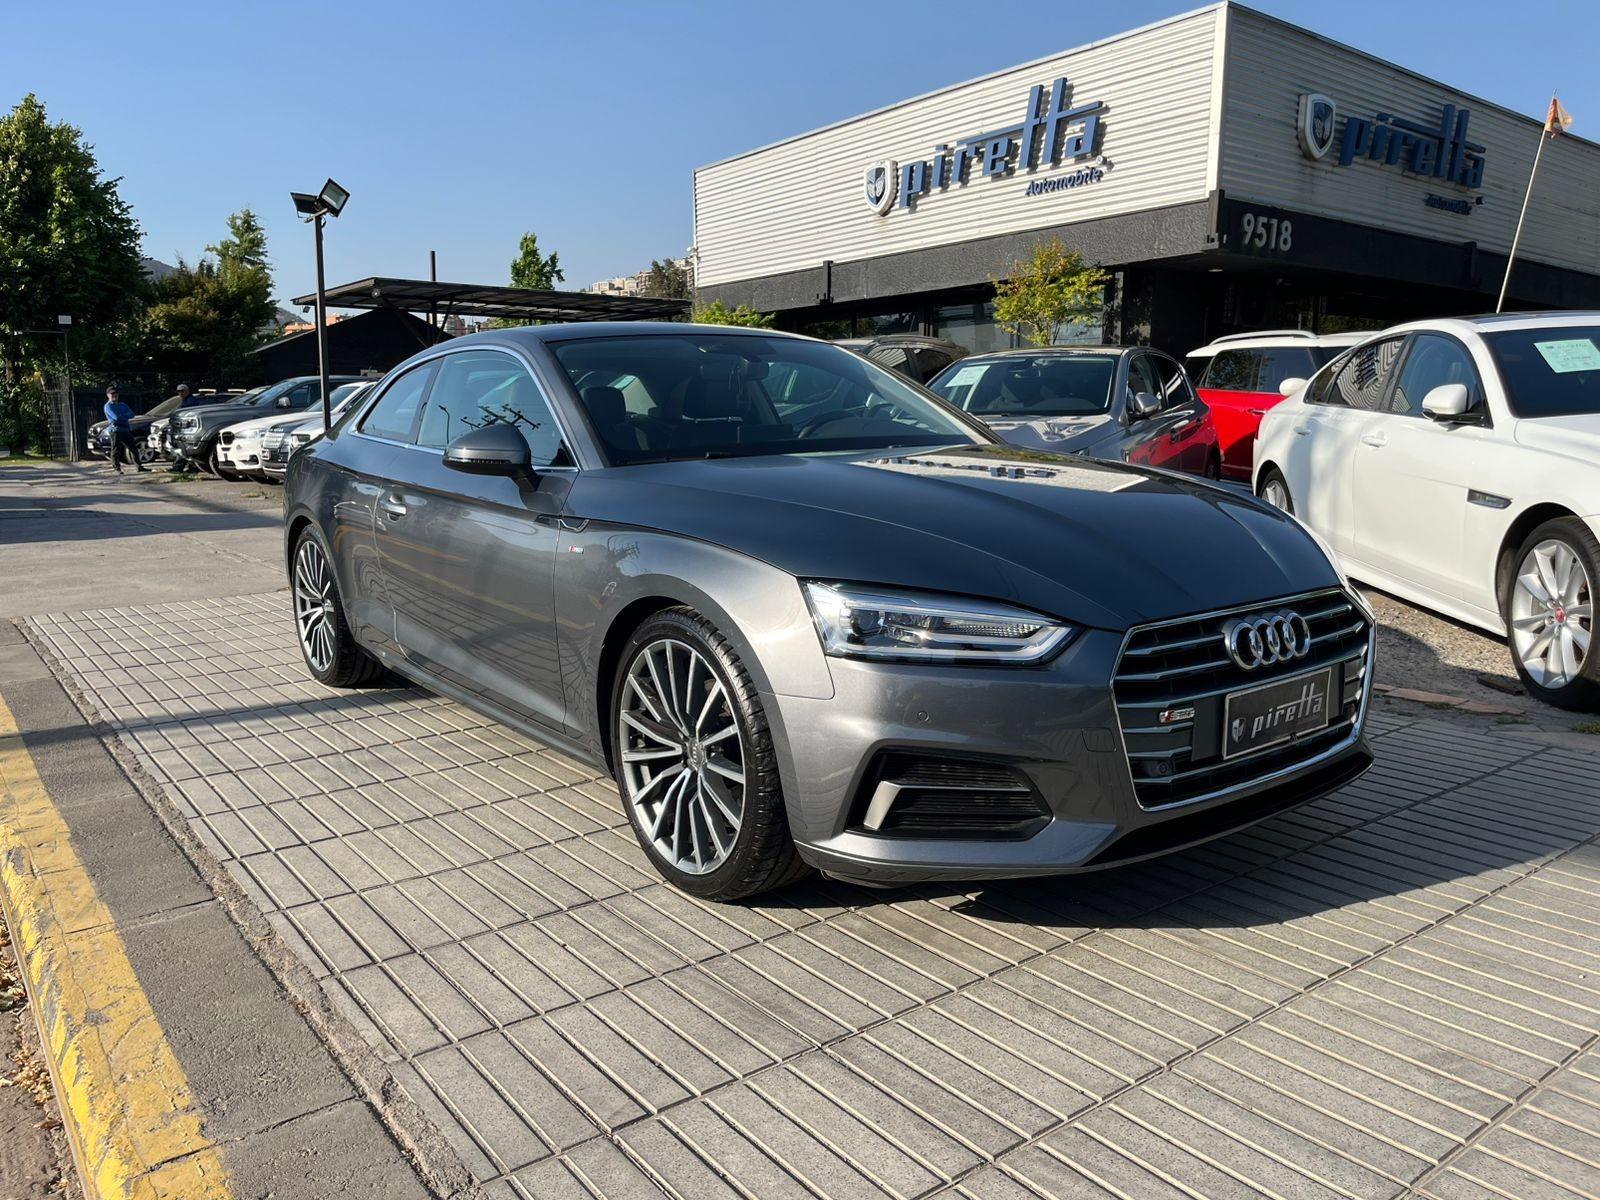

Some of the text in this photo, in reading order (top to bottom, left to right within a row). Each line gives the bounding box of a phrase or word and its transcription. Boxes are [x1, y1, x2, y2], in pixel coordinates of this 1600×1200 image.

[900, 76, 1103, 208] piretta
[1339, 104, 1486, 188] piretta
[1025, 166, 1103, 197] Automobile
[1242, 213, 1292, 252] 9518
[1251, 682, 1324, 739] piretta
